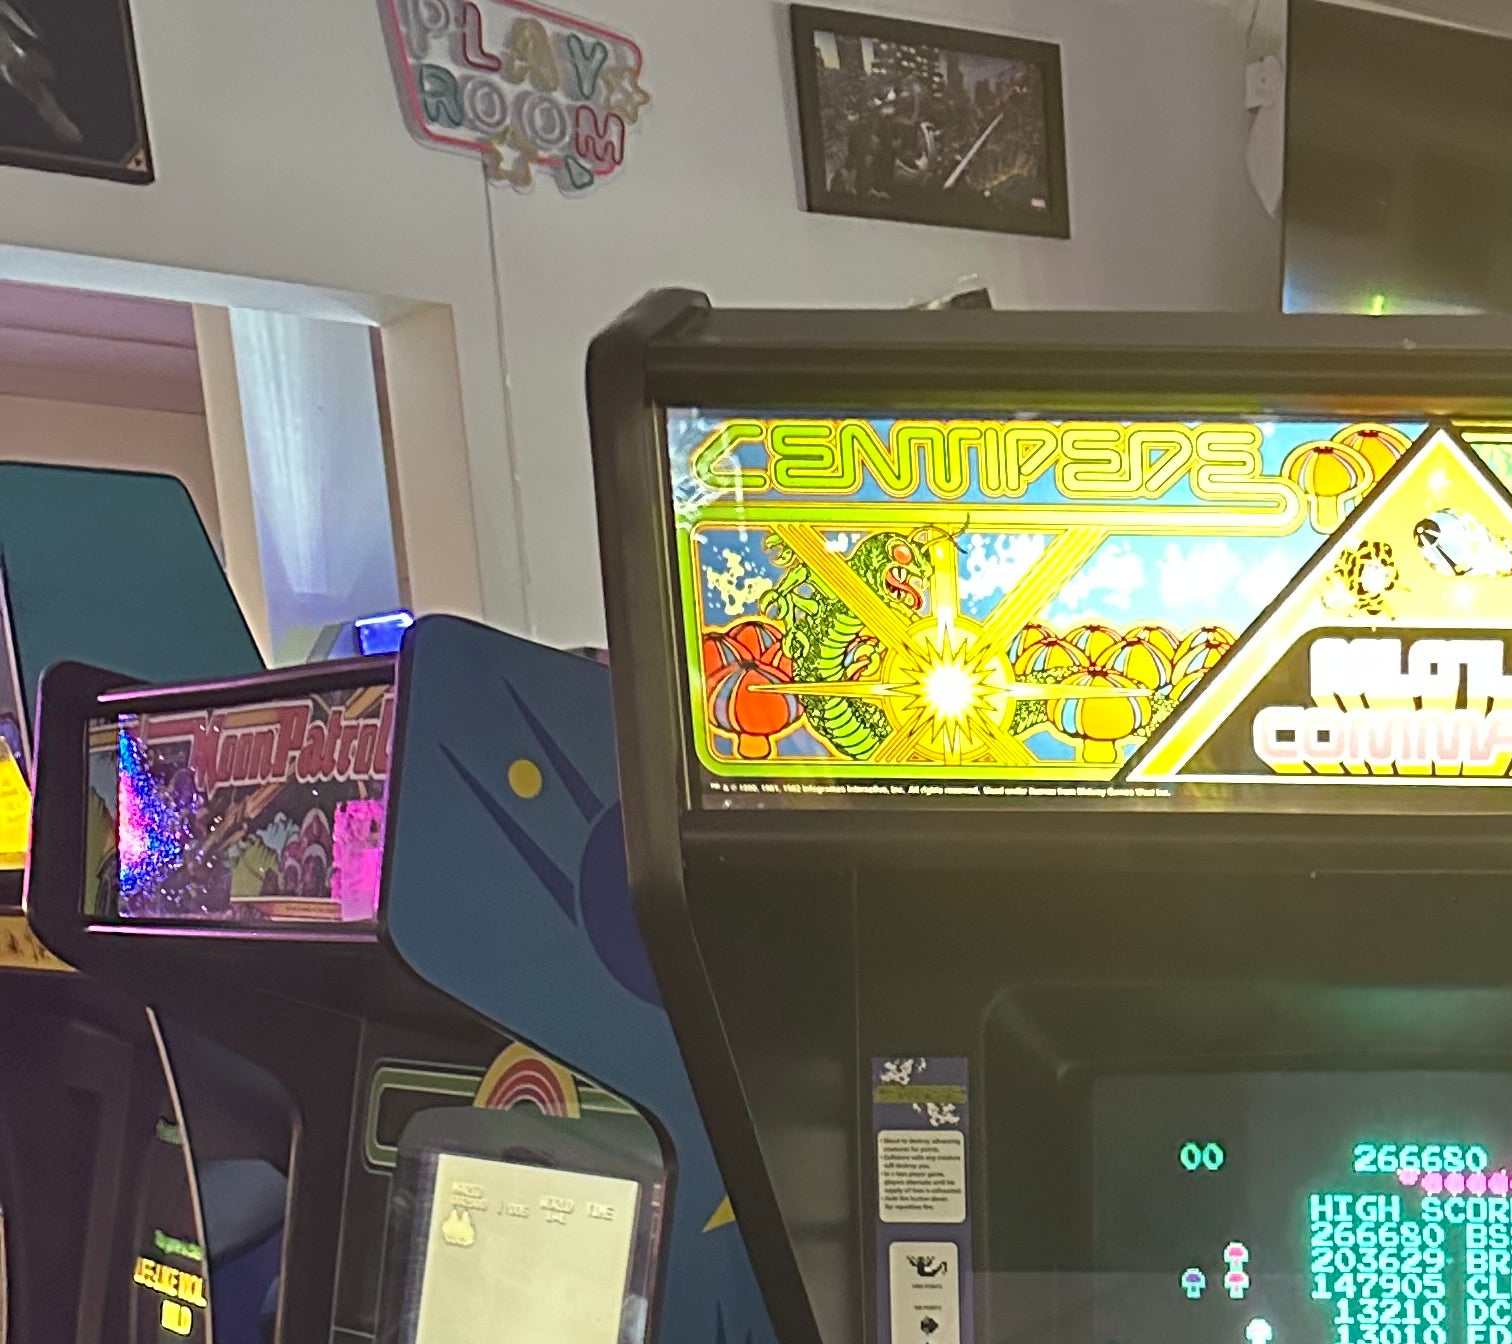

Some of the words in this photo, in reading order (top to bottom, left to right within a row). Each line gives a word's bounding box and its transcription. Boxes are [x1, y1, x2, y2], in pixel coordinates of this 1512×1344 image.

[402, 0, 609, 100] PLAY
[418, 62, 627, 166] ROOM
[688, 418, 1272, 500] CENTIPEDE
[1180, 1142, 1224, 1171] 00
[1353, 1144, 1488, 1173] 266680
[1309, 1194, 1400, 1224] HIGH
[1310, 1221, 1445, 1249] 266680
[1310, 1247, 1446, 1275] 203629
[1311, 1273, 1446, 1300] 147905
[1334, 1299, 1446, 1325] 13210
